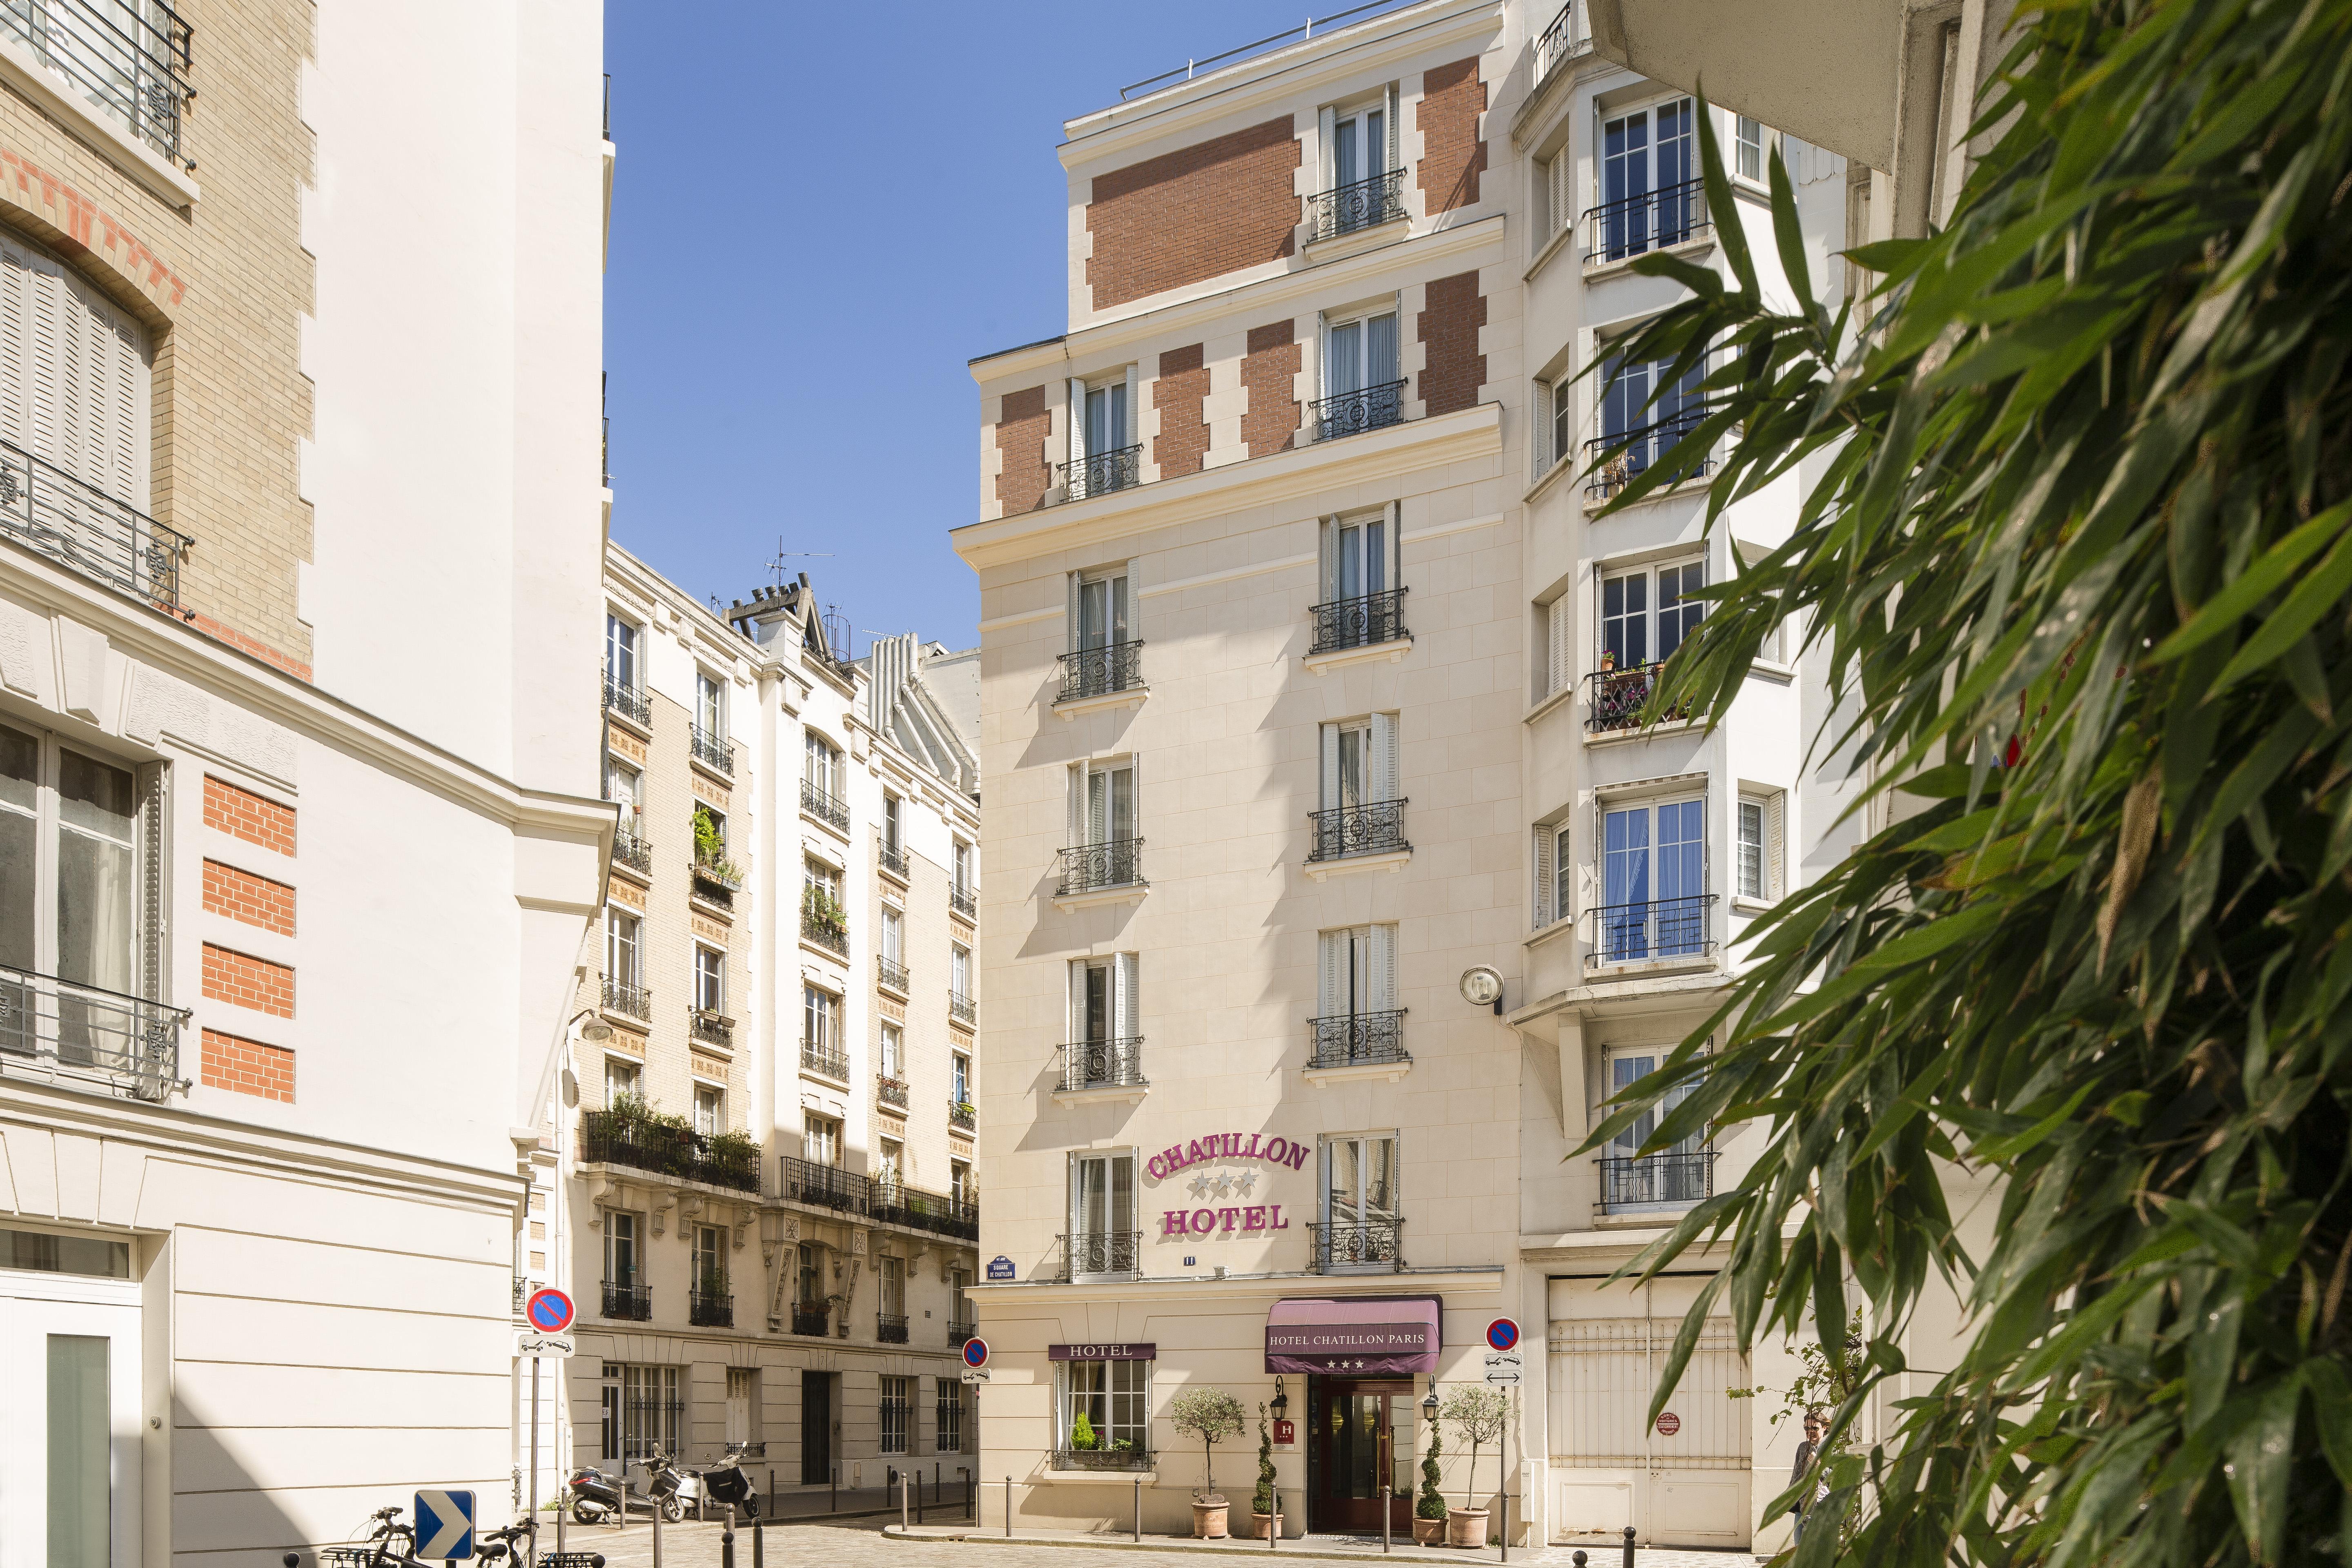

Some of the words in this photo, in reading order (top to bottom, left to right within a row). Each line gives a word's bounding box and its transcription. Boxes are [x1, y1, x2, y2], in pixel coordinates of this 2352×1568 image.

[1148, 1133, 1310, 1179] CHATILLON
[1163, 1205, 1288, 1234] HOTEL
[1270, 1336, 1310, 1345] HOTEL
[1313, 1335, 1385, 1345] CHATILLON
[1389, 1334, 1424, 1344] PARIS
[1069, 1345, 1133, 1356] HOTEL
[821, 1356, 824, 1365] 7
[1283, 1425, 1291, 1434] H
